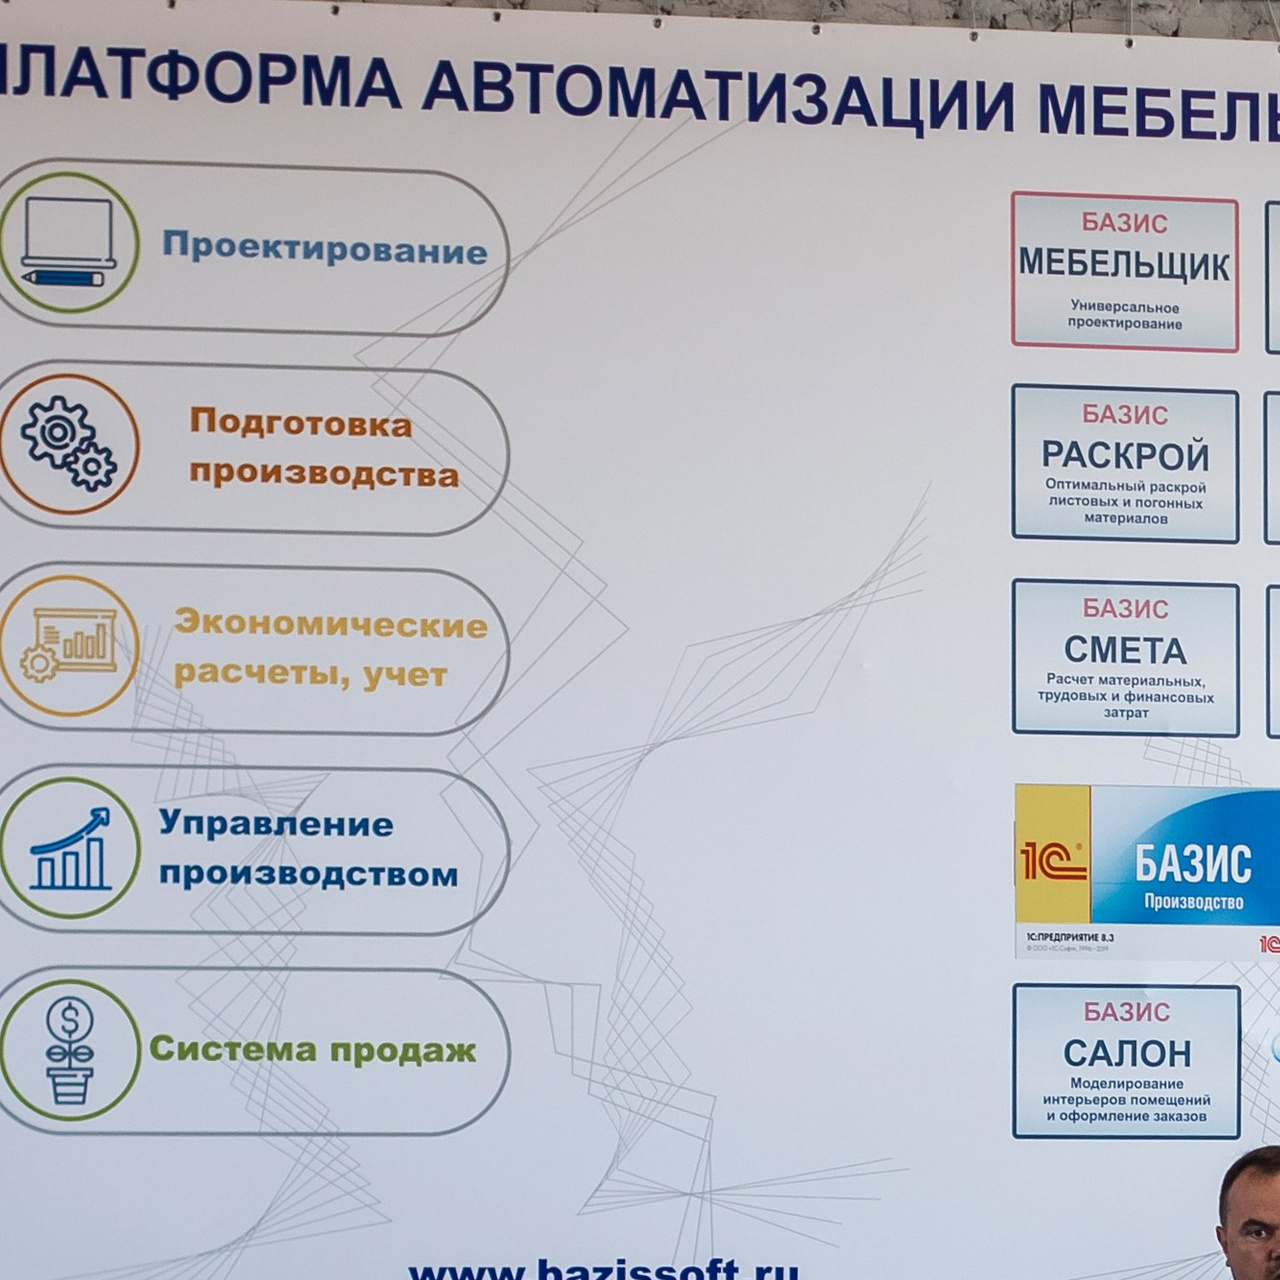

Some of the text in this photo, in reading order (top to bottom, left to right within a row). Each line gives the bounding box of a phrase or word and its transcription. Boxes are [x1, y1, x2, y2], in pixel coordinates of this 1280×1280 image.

[0, 43, 402, 108] ЛАТФОРМА
[422, 60, 1013, 139] АВТОМАТИЗАЦИИ
[1083, 212, 1167, 233] БАЗИС
[164, 230, 487, 266] Проектирование
[1019, 247, 1230, 284] МЕБЕЛЬЩИК
[1070, 298, 1180, 315] Универсальное
[1069, 315, 1183, 330] проектирование
[191, 407, 412, 439] Подготовка
[1084, 404, 1167, 425] БАЗИС
[1043, 437, 1208, 471] РАСКРОЙ
[191, 463, 458, 490] производства
[1045, 477, 1207, 495] Оптимальный раскрой
[1048, 496, 1203, 510] листовых и погонных
[1084, 513, 1169, 526] материалов
[1084, 598, 1168, 619] БАЗИС
[175, 607, 488, 639] Экономические
[1065, 635, 1187, 664] СМЕТА
[175, 663, 447, 692] расчеты, учет
[1046, 672, 1206, 689] Расчет материальных,
[1037, 690, 1215, 705] трудовых и финансовых
[1104, 708, 1150, 721] затрат
[159, 809, 393, 841] Управление
[1136, 843, 1252, 884] БАЗИС
[160, 865, 457, 890] производством
[1145, 893, 1243, 911] Производство
[1026, 932, 1115, 943] 1С:ПРЕДПРИЯТИЕ 8.3
[1085, 1002, 1169, 1021] БАЗИС
[150, 1034, 476, 1068] Система продаж
[1065, 1039, 1190, 1067] САЛОН
[1070, 1076, 1184, 1092] Моделирование
[1043, 1095, 1210, 1108] интерьеров помещений
[1046, 1109, 1208, 1124] и оформление заказов
